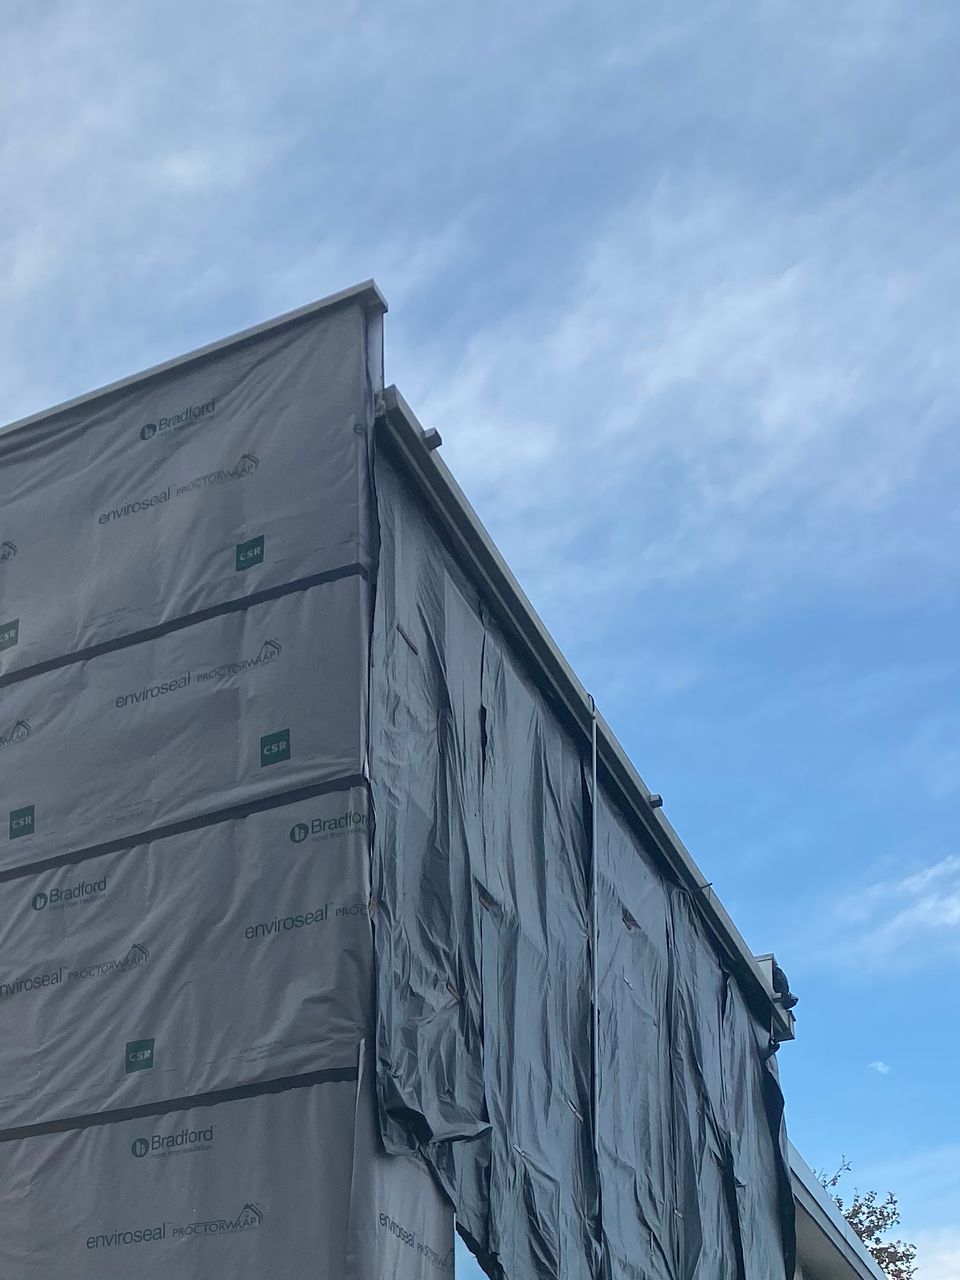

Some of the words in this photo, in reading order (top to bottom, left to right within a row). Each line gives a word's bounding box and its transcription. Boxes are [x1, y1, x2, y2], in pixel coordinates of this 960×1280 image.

[158, 399, 215, 431] Bradford
[98, 486, 171, 525] enviroseal
[239, 545, 261, 560] CSR
[115, 672, 191, 708] enviroseal
[263, 741, 287, 755] CSR
[12, 815, 32, 829] CSR
[311, 810, 368, 834] Bradfor
[49, 876, 107, 903] Bradford
[245, 903, 328, 940] enviroseal
[128, 1049, 152, 1063] CSR
[151, 1125, 213, 1150] Bradford
[87, 1222, 166, 1249] enviroseal
